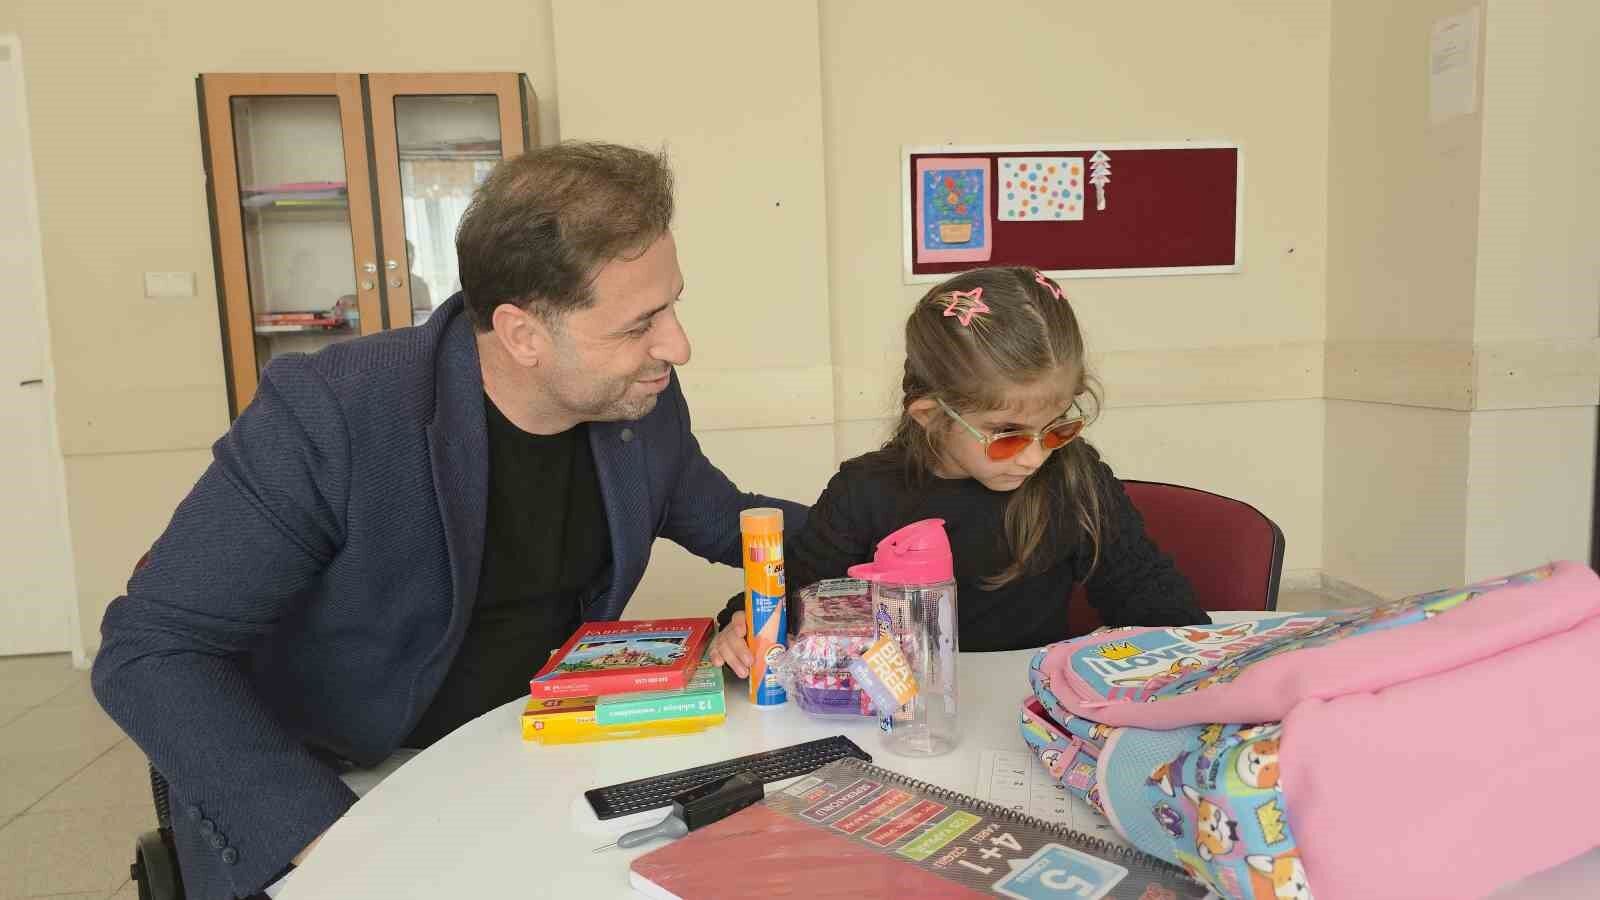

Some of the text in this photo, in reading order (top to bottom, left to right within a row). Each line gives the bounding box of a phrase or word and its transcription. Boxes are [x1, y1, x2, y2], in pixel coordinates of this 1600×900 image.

[880, 641, 911, 681] BPA
[1104, 643, 1201, 672] LOVE
[958, 832, 1023, 875] 4+1
[1039, 868, 1094, 898] 5
